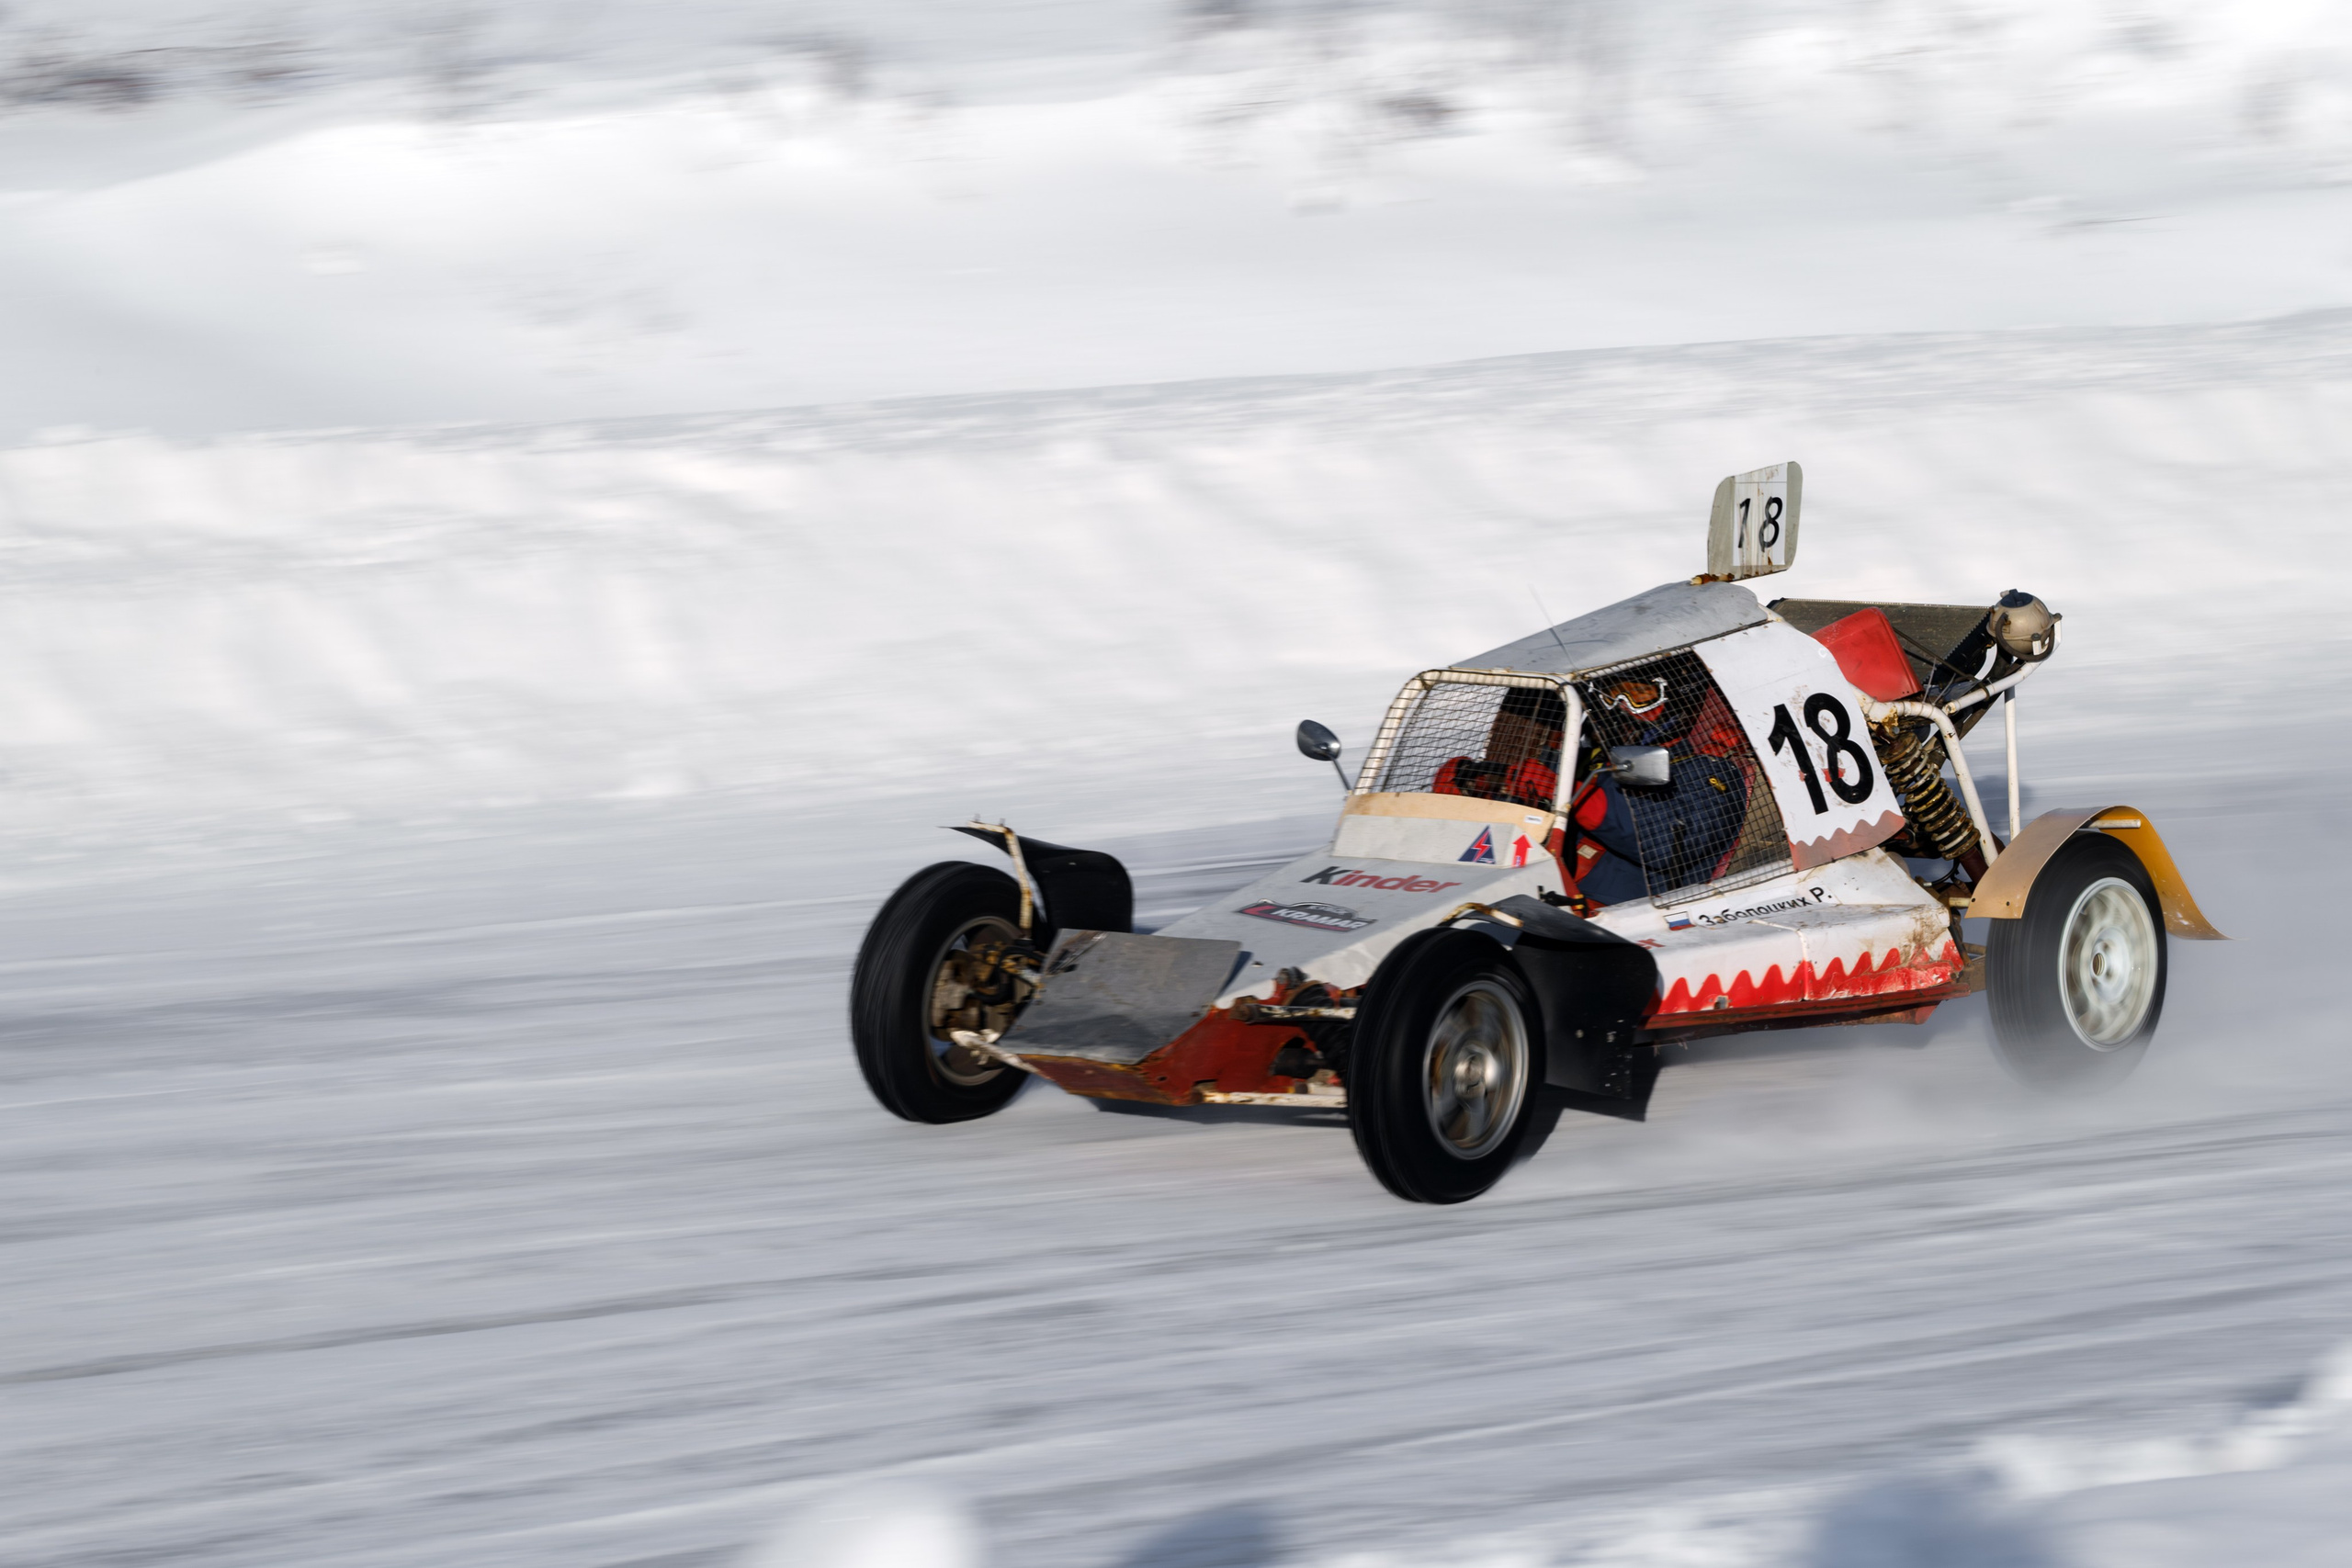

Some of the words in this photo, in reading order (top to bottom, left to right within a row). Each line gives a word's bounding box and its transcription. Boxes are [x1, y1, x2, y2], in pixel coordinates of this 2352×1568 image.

[1738, 496, 1783, 553] 18
[1768, 693, 1874, 816] 18
[1299, 865, 1463, 894] Kinder
[1271, 908, 1369, 930] KRAMAR
